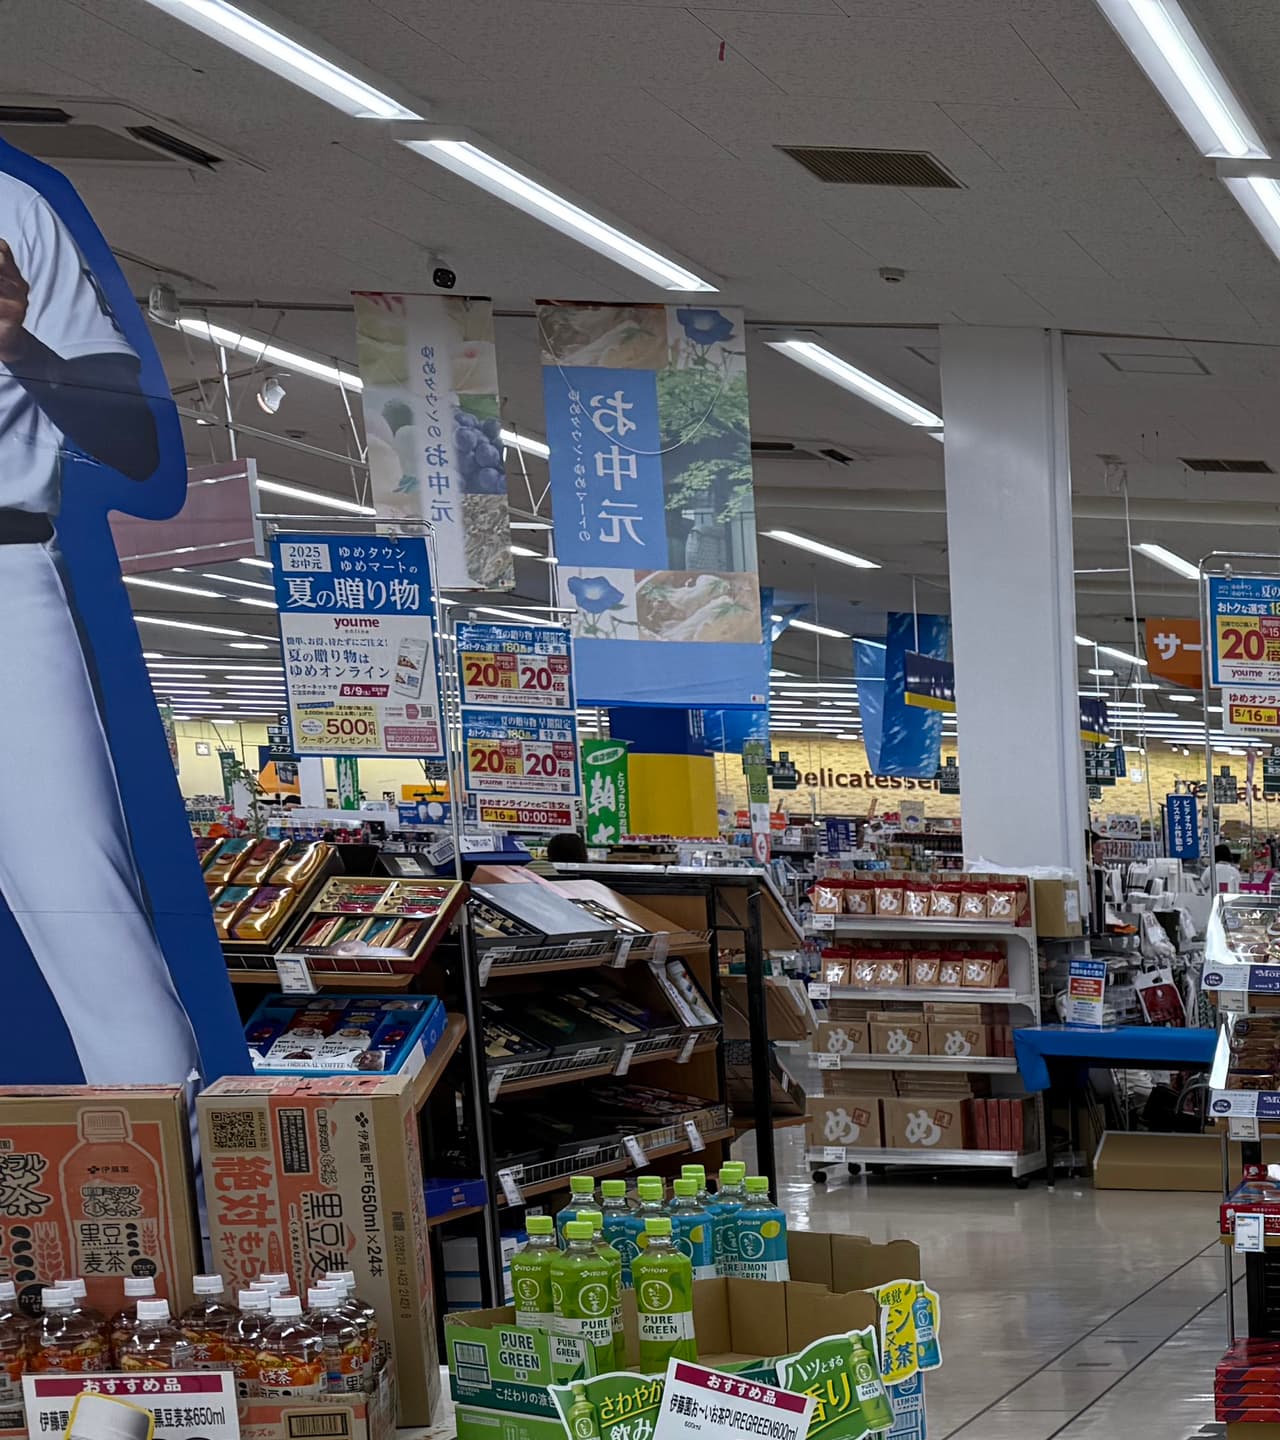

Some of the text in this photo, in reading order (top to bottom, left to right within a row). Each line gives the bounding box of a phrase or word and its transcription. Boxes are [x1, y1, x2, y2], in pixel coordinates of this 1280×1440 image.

[289, 546, 321, 557] 2025
[338, 546, 406, 560] ゆめタウン
[290, 559, 323, 570] お中元
[340, 561, 418, 575] ゆめマートの
[283, 576, 420, 611] 夏の贈り物
[1217, 602, 1267, 615] おトクな選定
[1222, 629, 1265, 660] 20
[288, 649, 370, 664] 夏の贈り物は
[1266, 651, 1280, 661] 倍
[290, 664, 391, 679] ゆめオンライン
[466, 663, 500, 686] 20
[521, 667, 552, 690] 20
[1232, 669, 1263, 678] youme
[471, 749, 504, 772] 20
[518, 811, 547, 824] 10:00
[824, 1108, 859, 1144] め
[905, 1109, 941, 1145] め
[80, 1223, 124, 1247] 黒豆
[83, 1251, 126, 1274] 麦茶
[501, 1332, 533, 1350] PURE
[500, 1350, 540, 1369] GREEN
[83, 1377, 181, 1394] おすすめ品
[706, 1374, 777, 1405] おすすめ品
